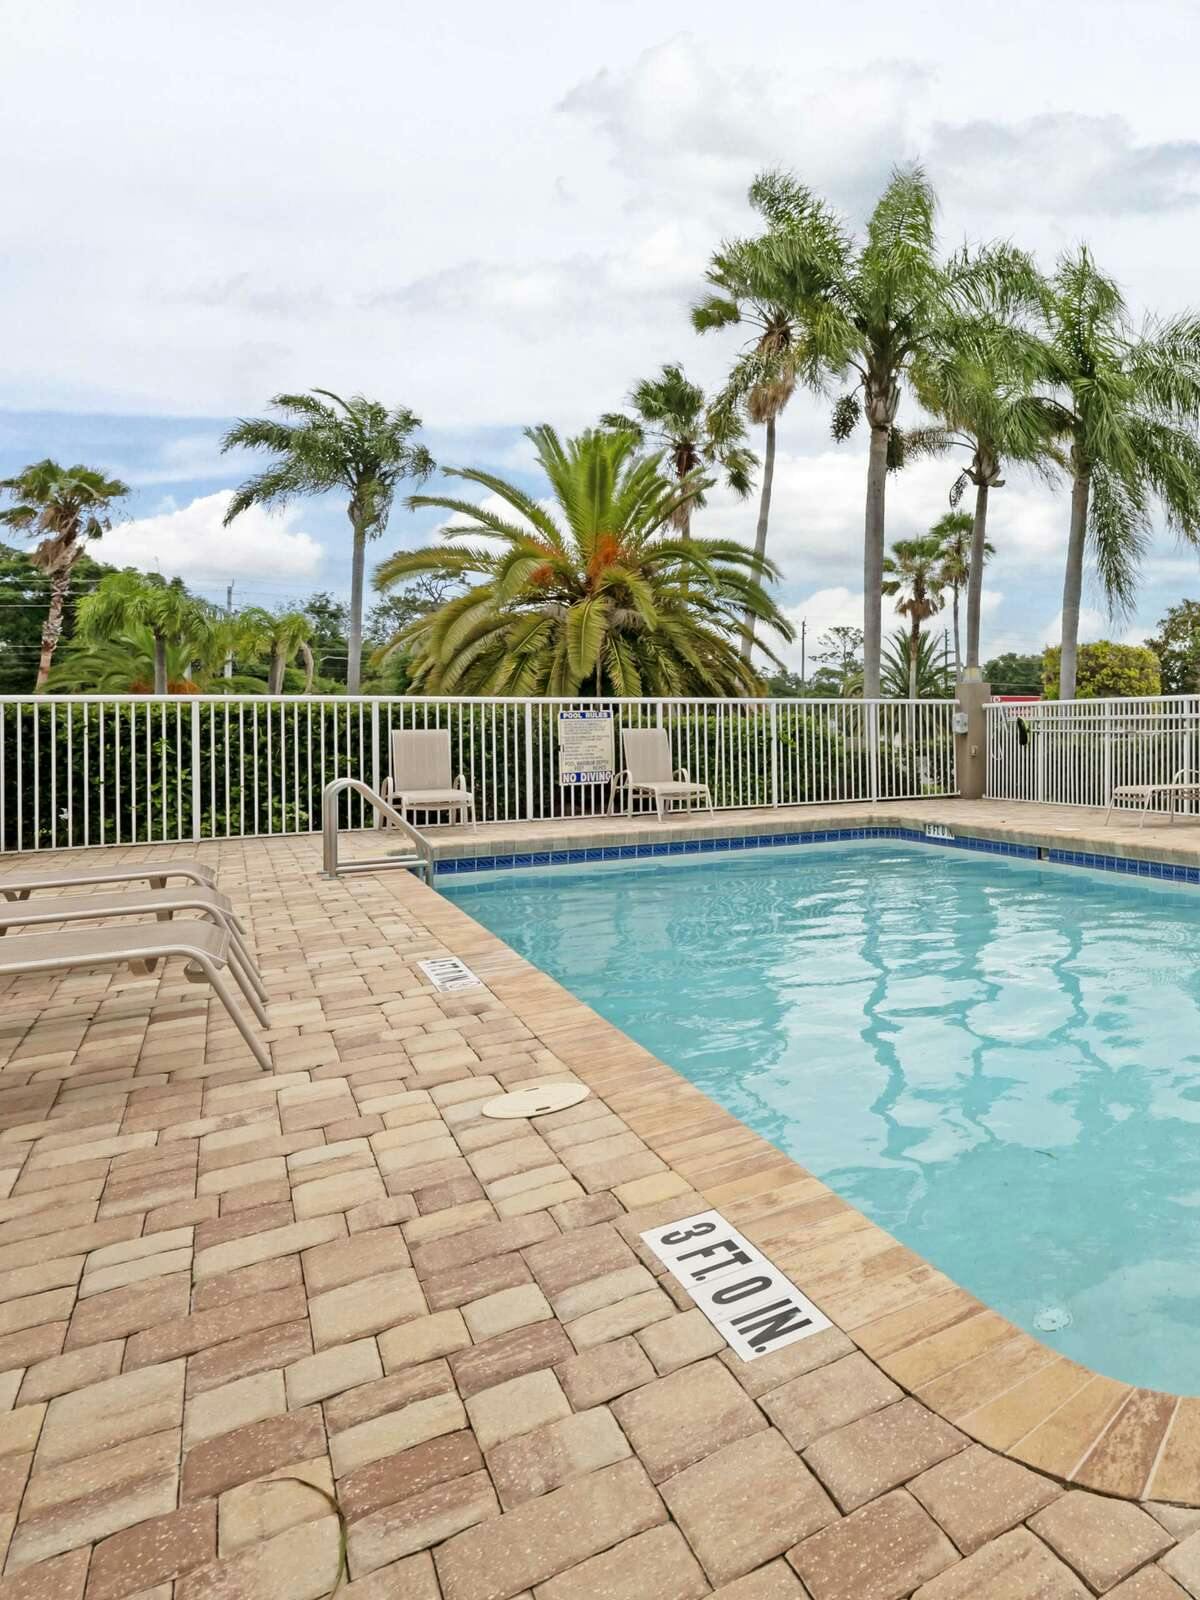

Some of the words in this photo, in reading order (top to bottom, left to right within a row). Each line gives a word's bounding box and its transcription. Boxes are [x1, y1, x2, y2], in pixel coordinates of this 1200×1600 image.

[563, 773, 576, 783] NO
[581, 771, 611, 782] DIVING
[660, 1222, 717, 1245] 3
[676, 1238, 753, 1282] FT.
[711, 1275, 773, 1305] 0
[730, 1298, 814, 1353] IN.
